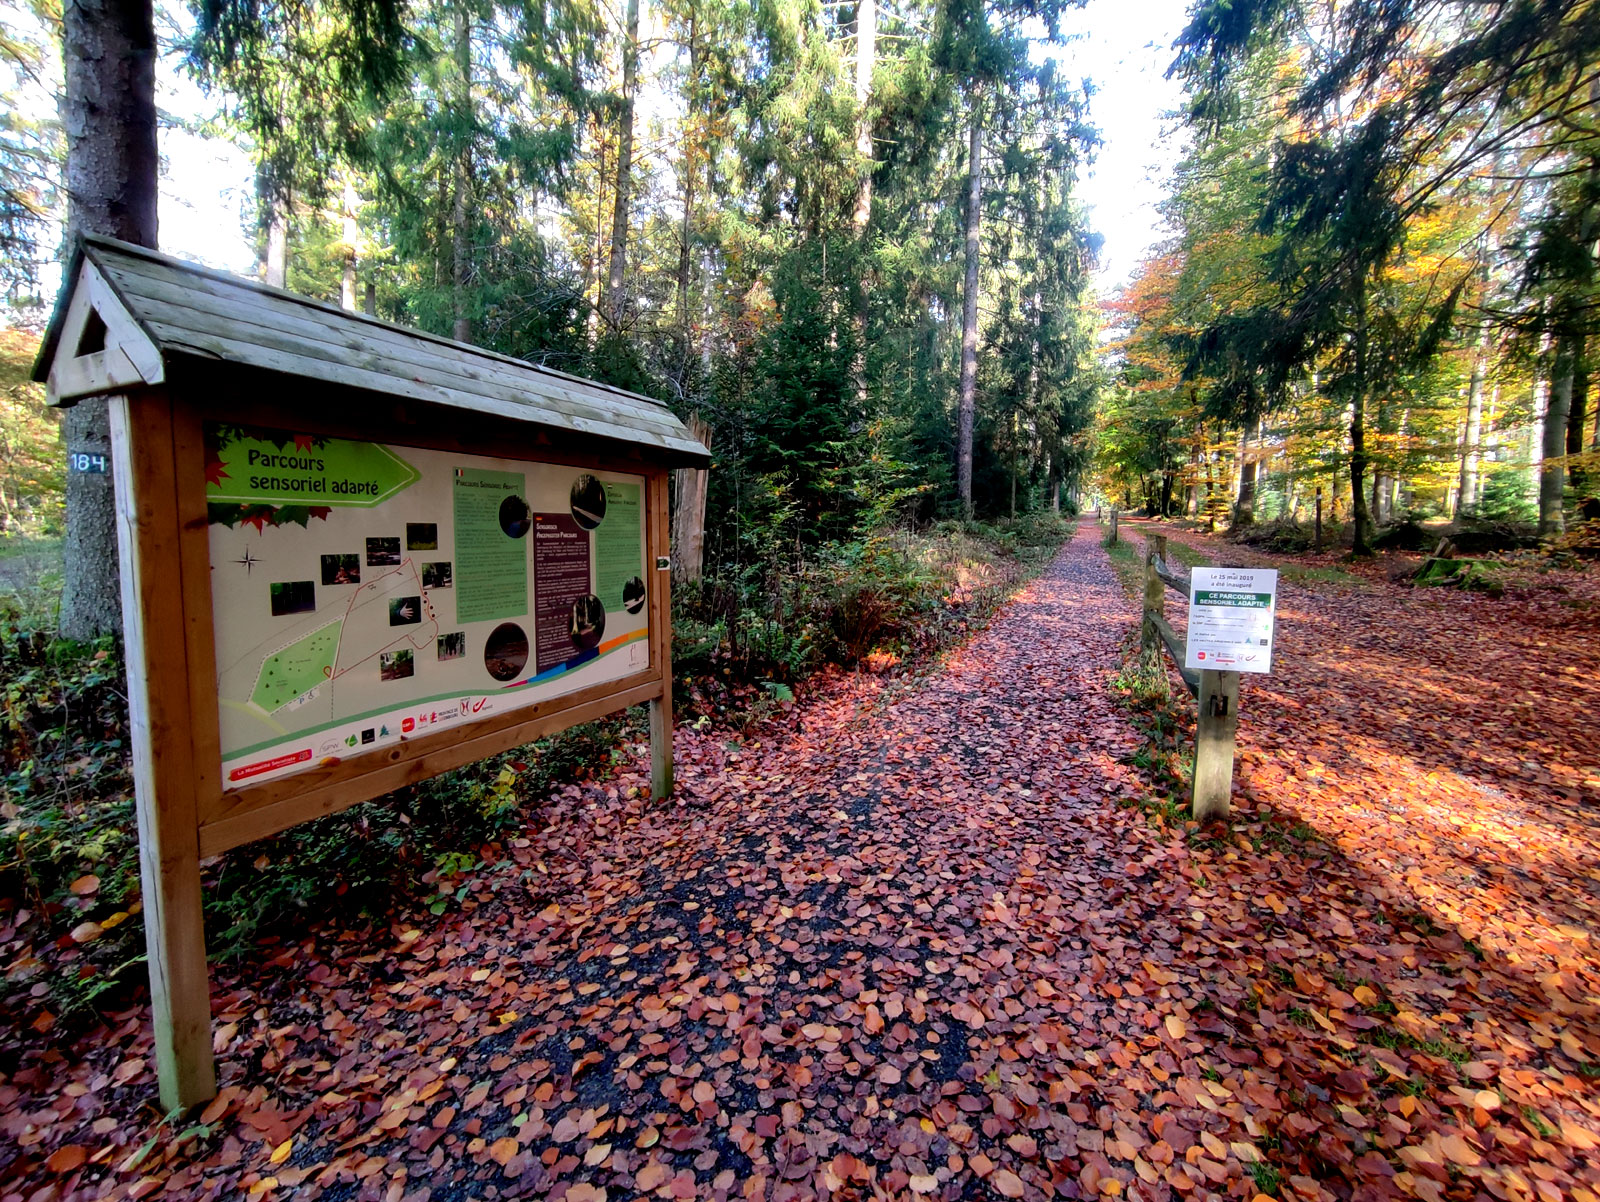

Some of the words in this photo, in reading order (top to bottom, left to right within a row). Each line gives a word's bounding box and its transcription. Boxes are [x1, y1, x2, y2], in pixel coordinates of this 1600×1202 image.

[71, 453, 105, 472] 184
[248, 449, 325, 472] Parcours
[250, 475, 326, 493] sensoriel
[331, 479, 379, 496] adapté
[1199, 598, 1237, 606] SENSORIEL
